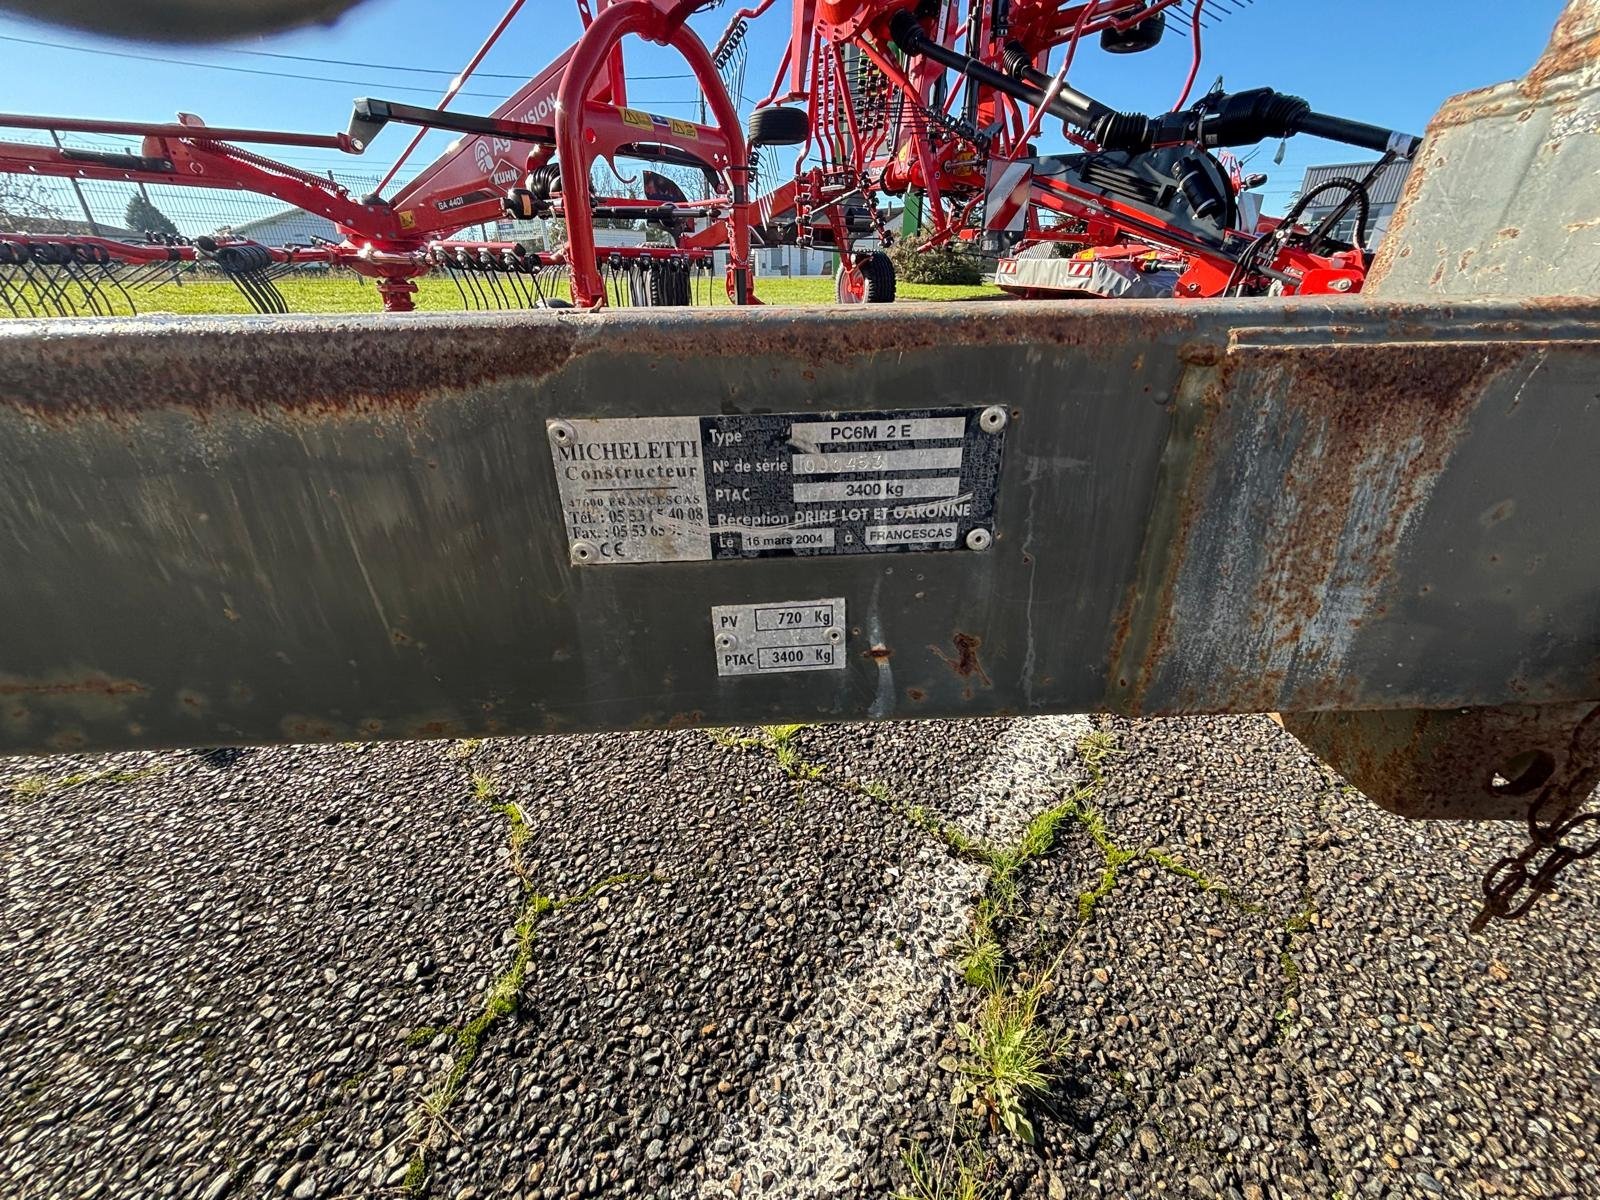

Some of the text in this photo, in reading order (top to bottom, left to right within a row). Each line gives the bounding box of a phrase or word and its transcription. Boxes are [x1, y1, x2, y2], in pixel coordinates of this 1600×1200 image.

[493, 169, 518, 185] KUHN
[438, 197, 464, 210] GA 4401
[709, 424, 912, 447] Type PC6M 2 E
[558, 440, 699, 462] MICHELETTI
[564, 464, 698, 481] Constructeur
[735, 458, 752, 473] de
[755, 457, 788, 472] série
[609, 494, 701, 507] FRANCESCAS
[715, 482, 904, 502] PTAC 3400 kg
[609, 509, 625, 523] 05
[668, 507, 684, 521] 40
[688, 507, 704, 521] 08
[717, 503, 971, 528] Réception DRIRE LOT ET GARONNE
[613, 525, 628, 538] 05
[631, 524, 647, 537] 53
[720, 535, 734, 549] Le
[746, 536, 760, 547] 16
[764, 536, 793, 546] mars
[796, 534, 823, 545] 2004
[869, 527, 953, 541] FRANCESCAS
[721, 610, 830, 628] PV 720 Kg
[725, 649, 831, 666] PTAC 3400 Kg
